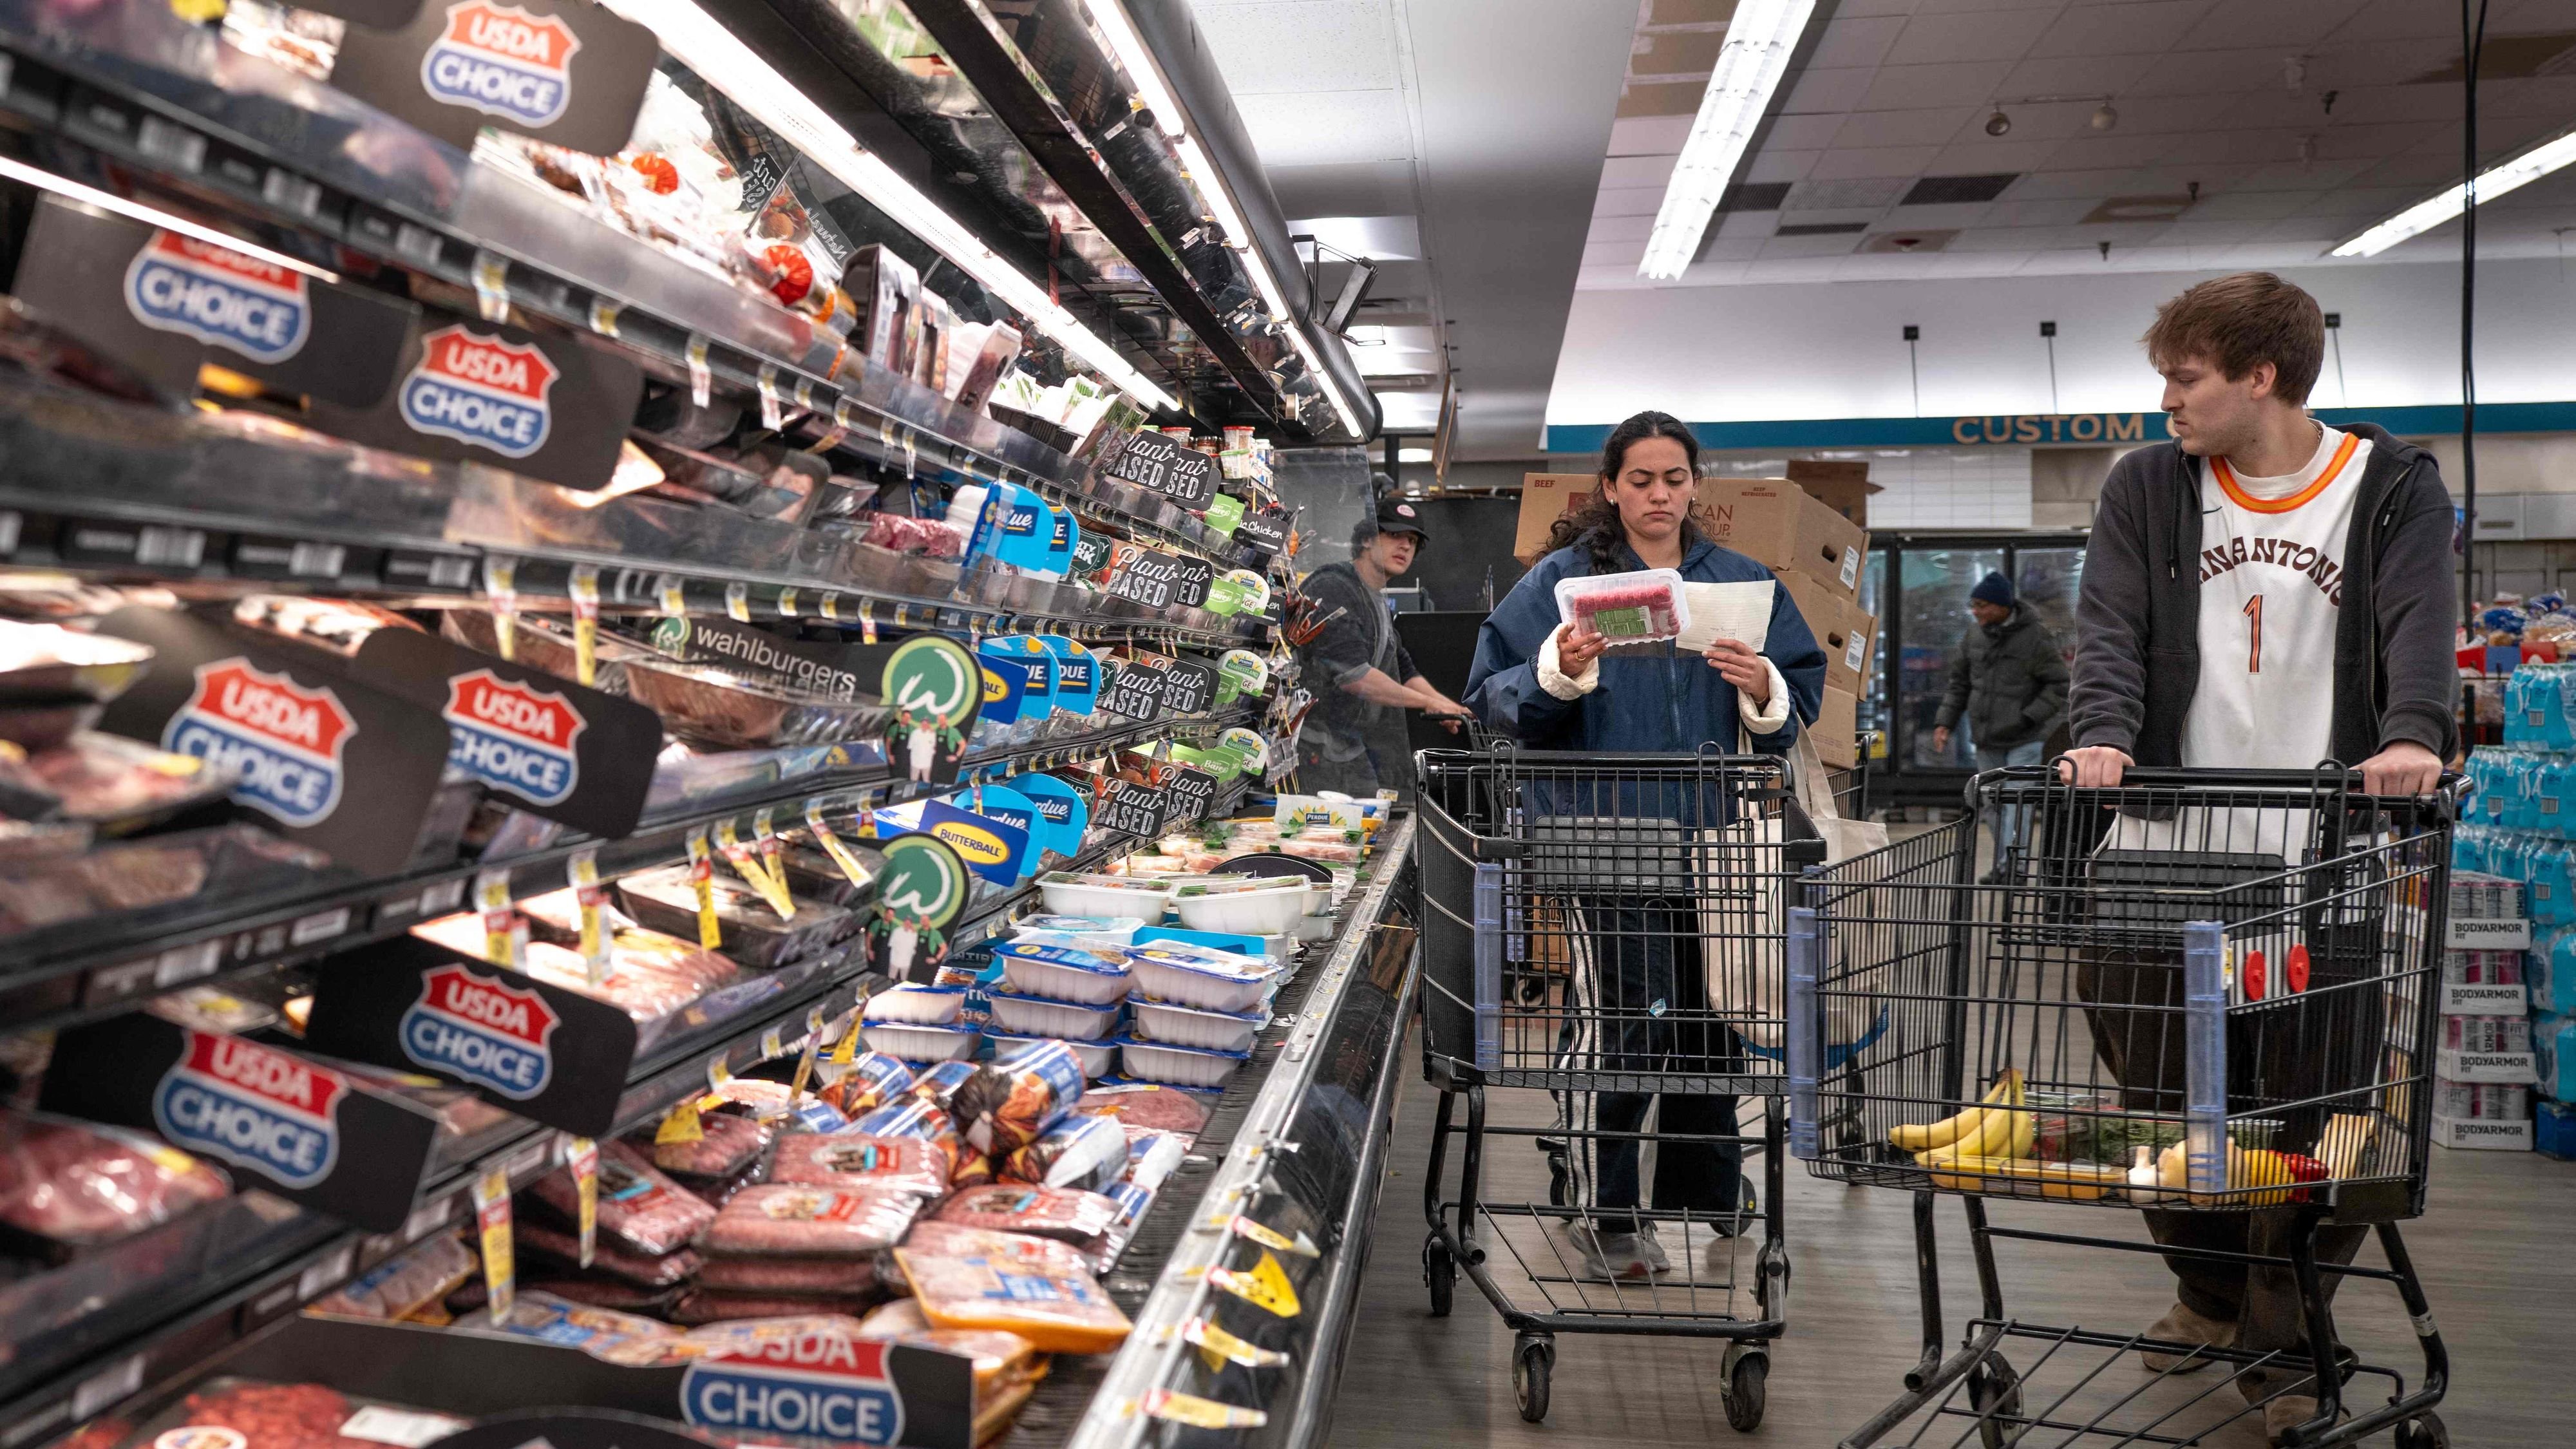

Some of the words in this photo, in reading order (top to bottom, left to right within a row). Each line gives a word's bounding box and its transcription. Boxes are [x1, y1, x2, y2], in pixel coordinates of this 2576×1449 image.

[470, 17, 552, 60] USDA
[432, 55, 556, 113] CHOICE
[140, 267, 296, 345] CHOICE
[446, 344, 529, 388] USDA
[412, 383, 536, 439] CHOICE
[1952, 414, 2144, 444] CUSTOM
[1127, 433, 1172, 462] lant
[1114, 453, 1164, 487] ASED
[1174, 457, 1206, 475] ant
[1166, 472, 1199, 499] SED
[1249, 521, 1282, 540] Chicken
[1116, 547, 1177, 582] Plant
[2200, 545, 2235, 584] AN
[1108, 569, 1168, 607] BASED
[2243, 594, 2263, 675] 1
[697, 625, 857, 687] wahlburgers
[1060, 665, 1088, 679] DUE
[220, 681, 321, 745] USDA
[1099, 687, 1153, 720] ASED
[1163, 685, 1196, 712] SED
[473, 692, 556, 741] USDA
[1102, 777, 1161, 810] Plant
[1157, 765, 1211, 797] Plant
[1034, 799, 1068, 815] rdue
[1096, 799, 1155, 835] BASED
[1164, 789, 1204, 819] SED
[940, 829, 1000, 857] BUTTERBALL
[2455, 923, 2523, 933] BODYARMOR
[446, 985, 531, 1035] USDA
[2452, 989, 2519, 999] BODYARMOR
[412, 1021, 536, 1083] CHOICE
[2461, 1057, 2528, 1066] BODYARMOR
[211, 1048, 312, 1108] USDA
[170, 1088, 322, 1173] CHOICE
[2455, 1124, 2523, 1135] BODYARMOR
[700, 1381, 884, 1441] CHOICE
